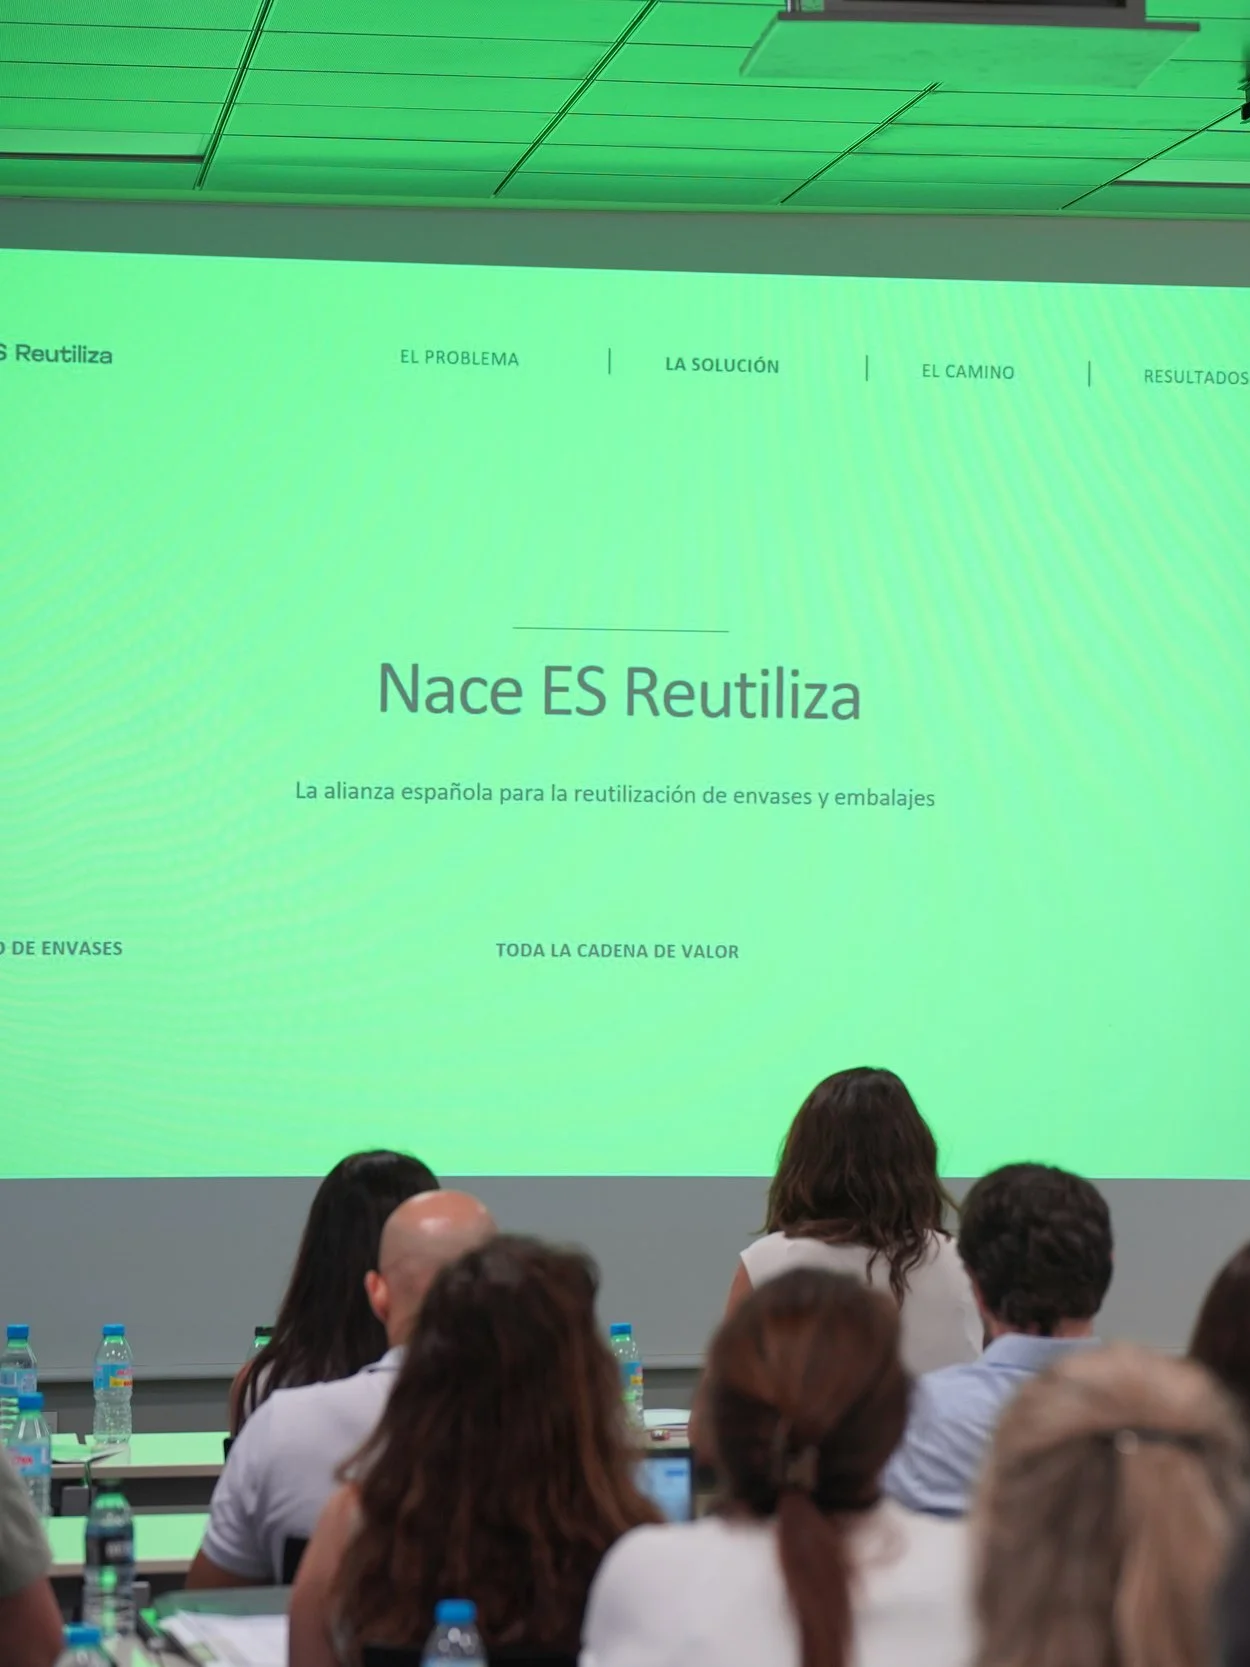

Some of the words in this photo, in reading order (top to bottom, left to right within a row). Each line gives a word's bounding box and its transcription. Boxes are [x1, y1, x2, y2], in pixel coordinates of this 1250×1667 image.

[16, 344, 112, 364] Reutiliza
[401, 349, 419, 363] EL
[425, 350, 519, 366] PROBLEMA
[666, 357, 686, 371] LA
[692, 357, 778, 373] SOLUCIÓN
[923, 364, 940, 377] EL
[946, 365, 1014, 379] CAMINO
[1145, 369, 1249, 385] RESULTADOS
[381, 663, 522, 715] Nace
[545, 665, 606, 716] ES
[627, 666, 859, 720] Reutiliza
[297, 782, 317, 799] La
[324, 781, 394, 799] alianza
[402, 783, 492, 804] española
[500, 788, 544, 804] para
[552, 784, 567, 801] la
[575, 785, 695, 803] reutilización
[703, 786, 726, 803] de
[734, 791, 812, 804] envases
[818, 792, 829, 808] y
[835, 788, 934, 810] embalajes
[12, 941, 35, 955] DE
[42, 941, 122, 955] ENVASES
[496, 943, 545, 957] TODA
[551, 944, 571, 957] LA
[578, 944, 648, 957] CADENA
[654, 944, 675, 958] DE
[682, 945, 738, 958] VALOR
